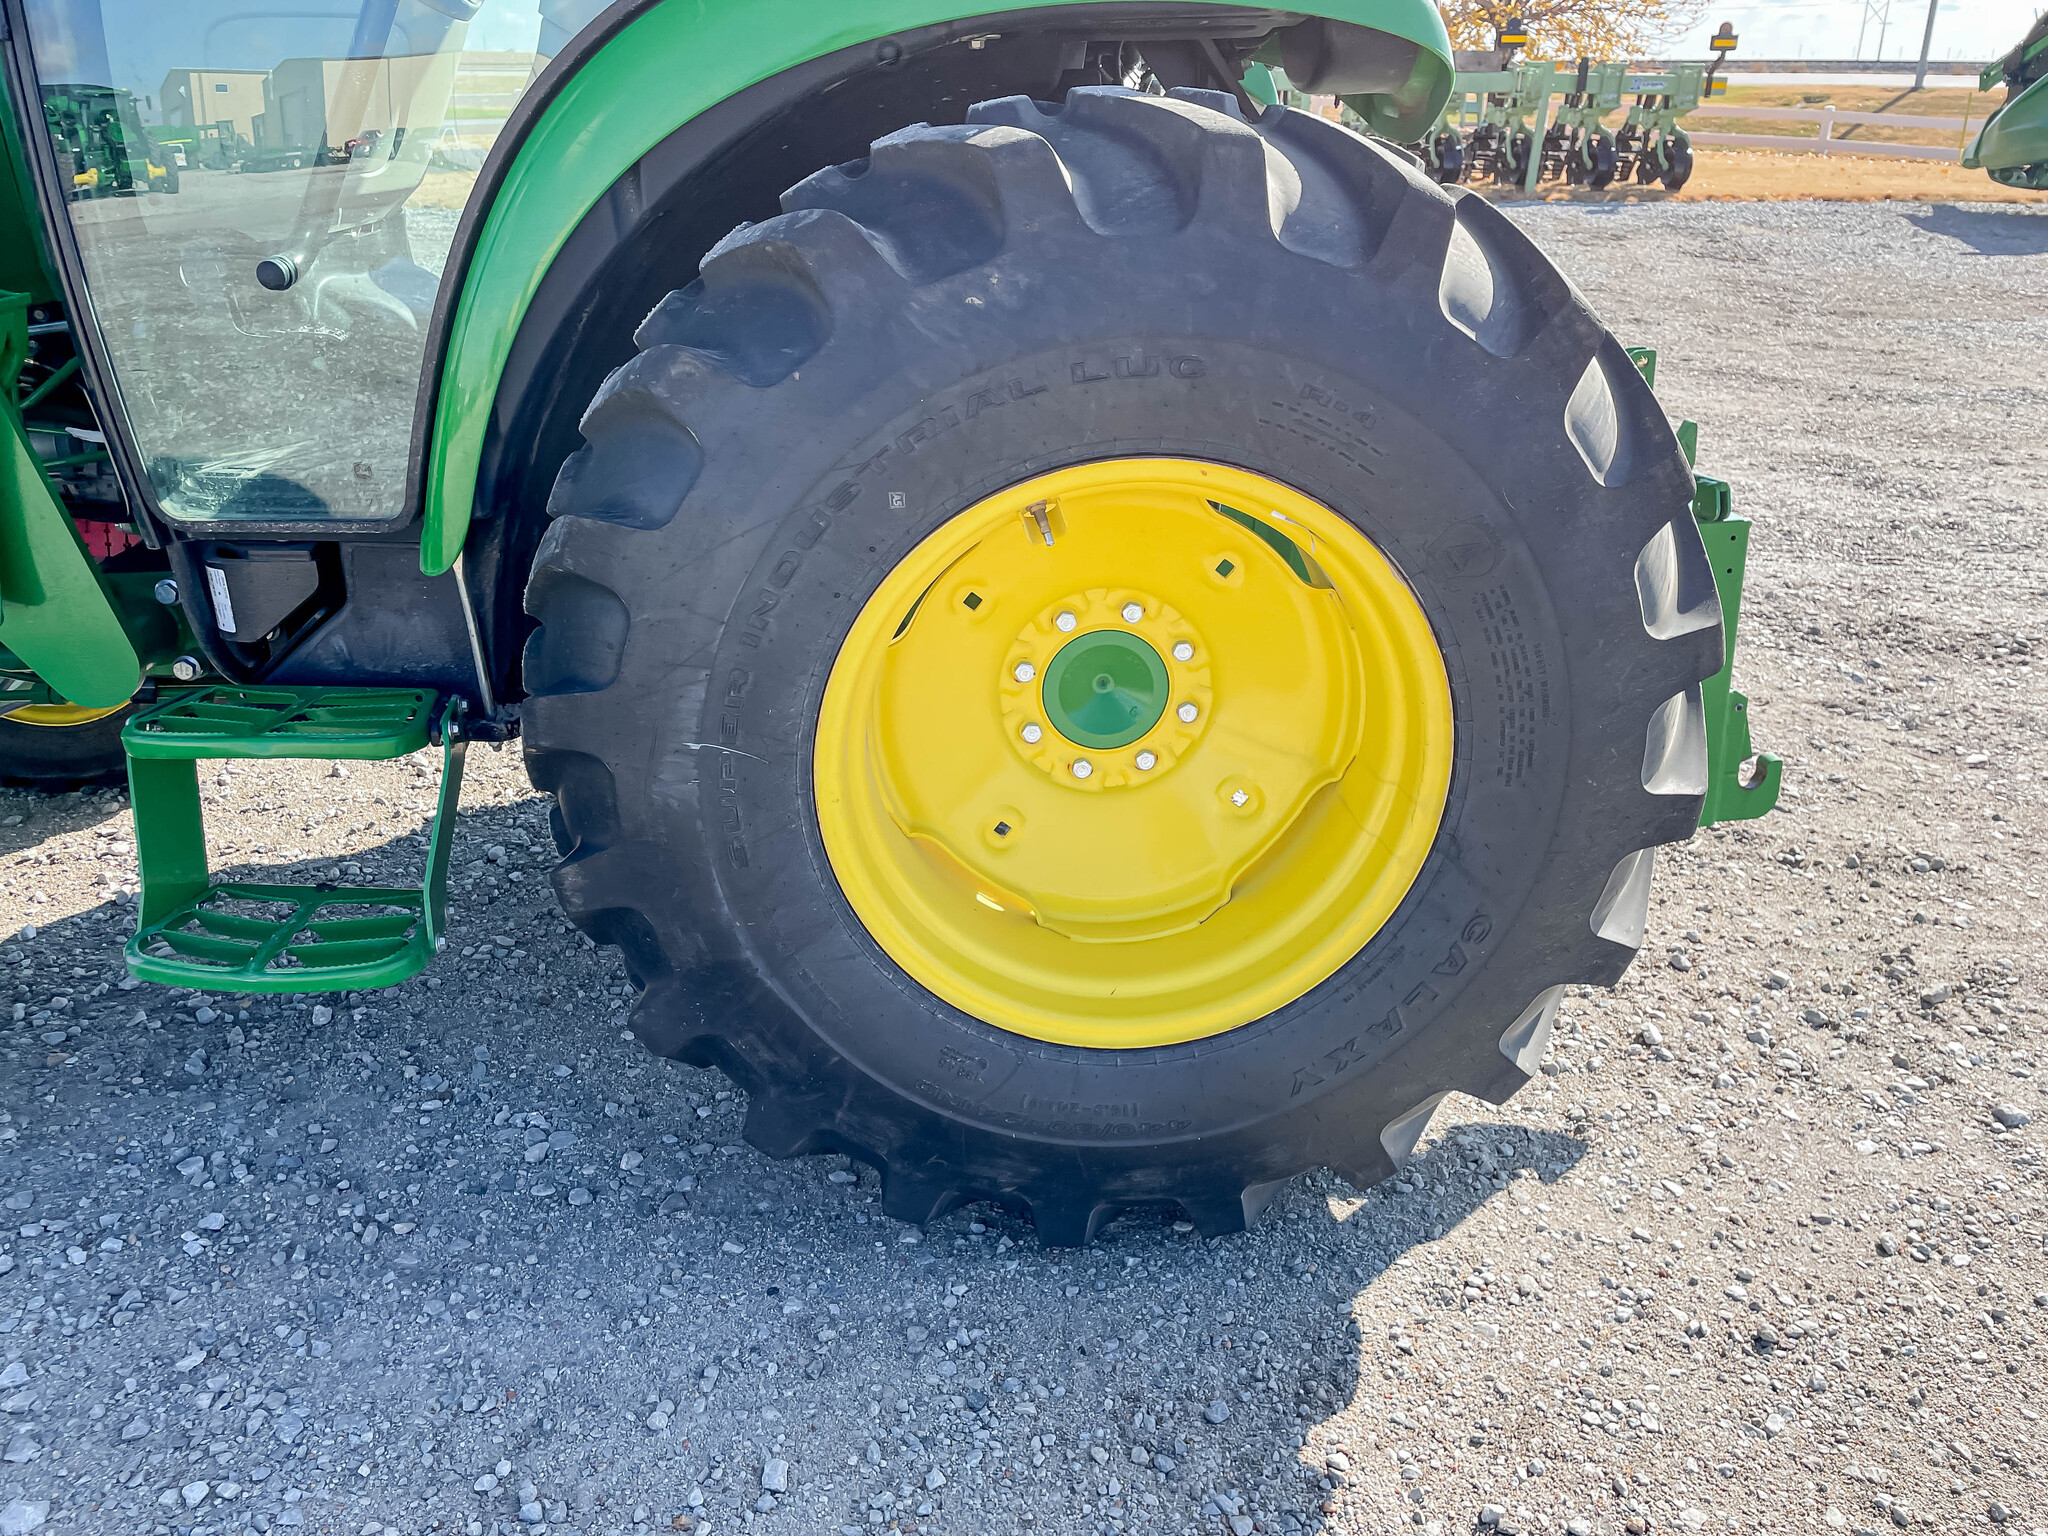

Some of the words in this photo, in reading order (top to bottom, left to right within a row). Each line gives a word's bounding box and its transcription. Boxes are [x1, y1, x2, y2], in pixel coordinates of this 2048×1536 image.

[1300, 382, 1378, 431] R-4
[718, 667, 751, 870] SUPER
[740, 376, 1050, 651] INDUSTRIAL
[1070, 354, 1208, 386] LUG
[1290, 911, 1493, 1097] GALAXY
